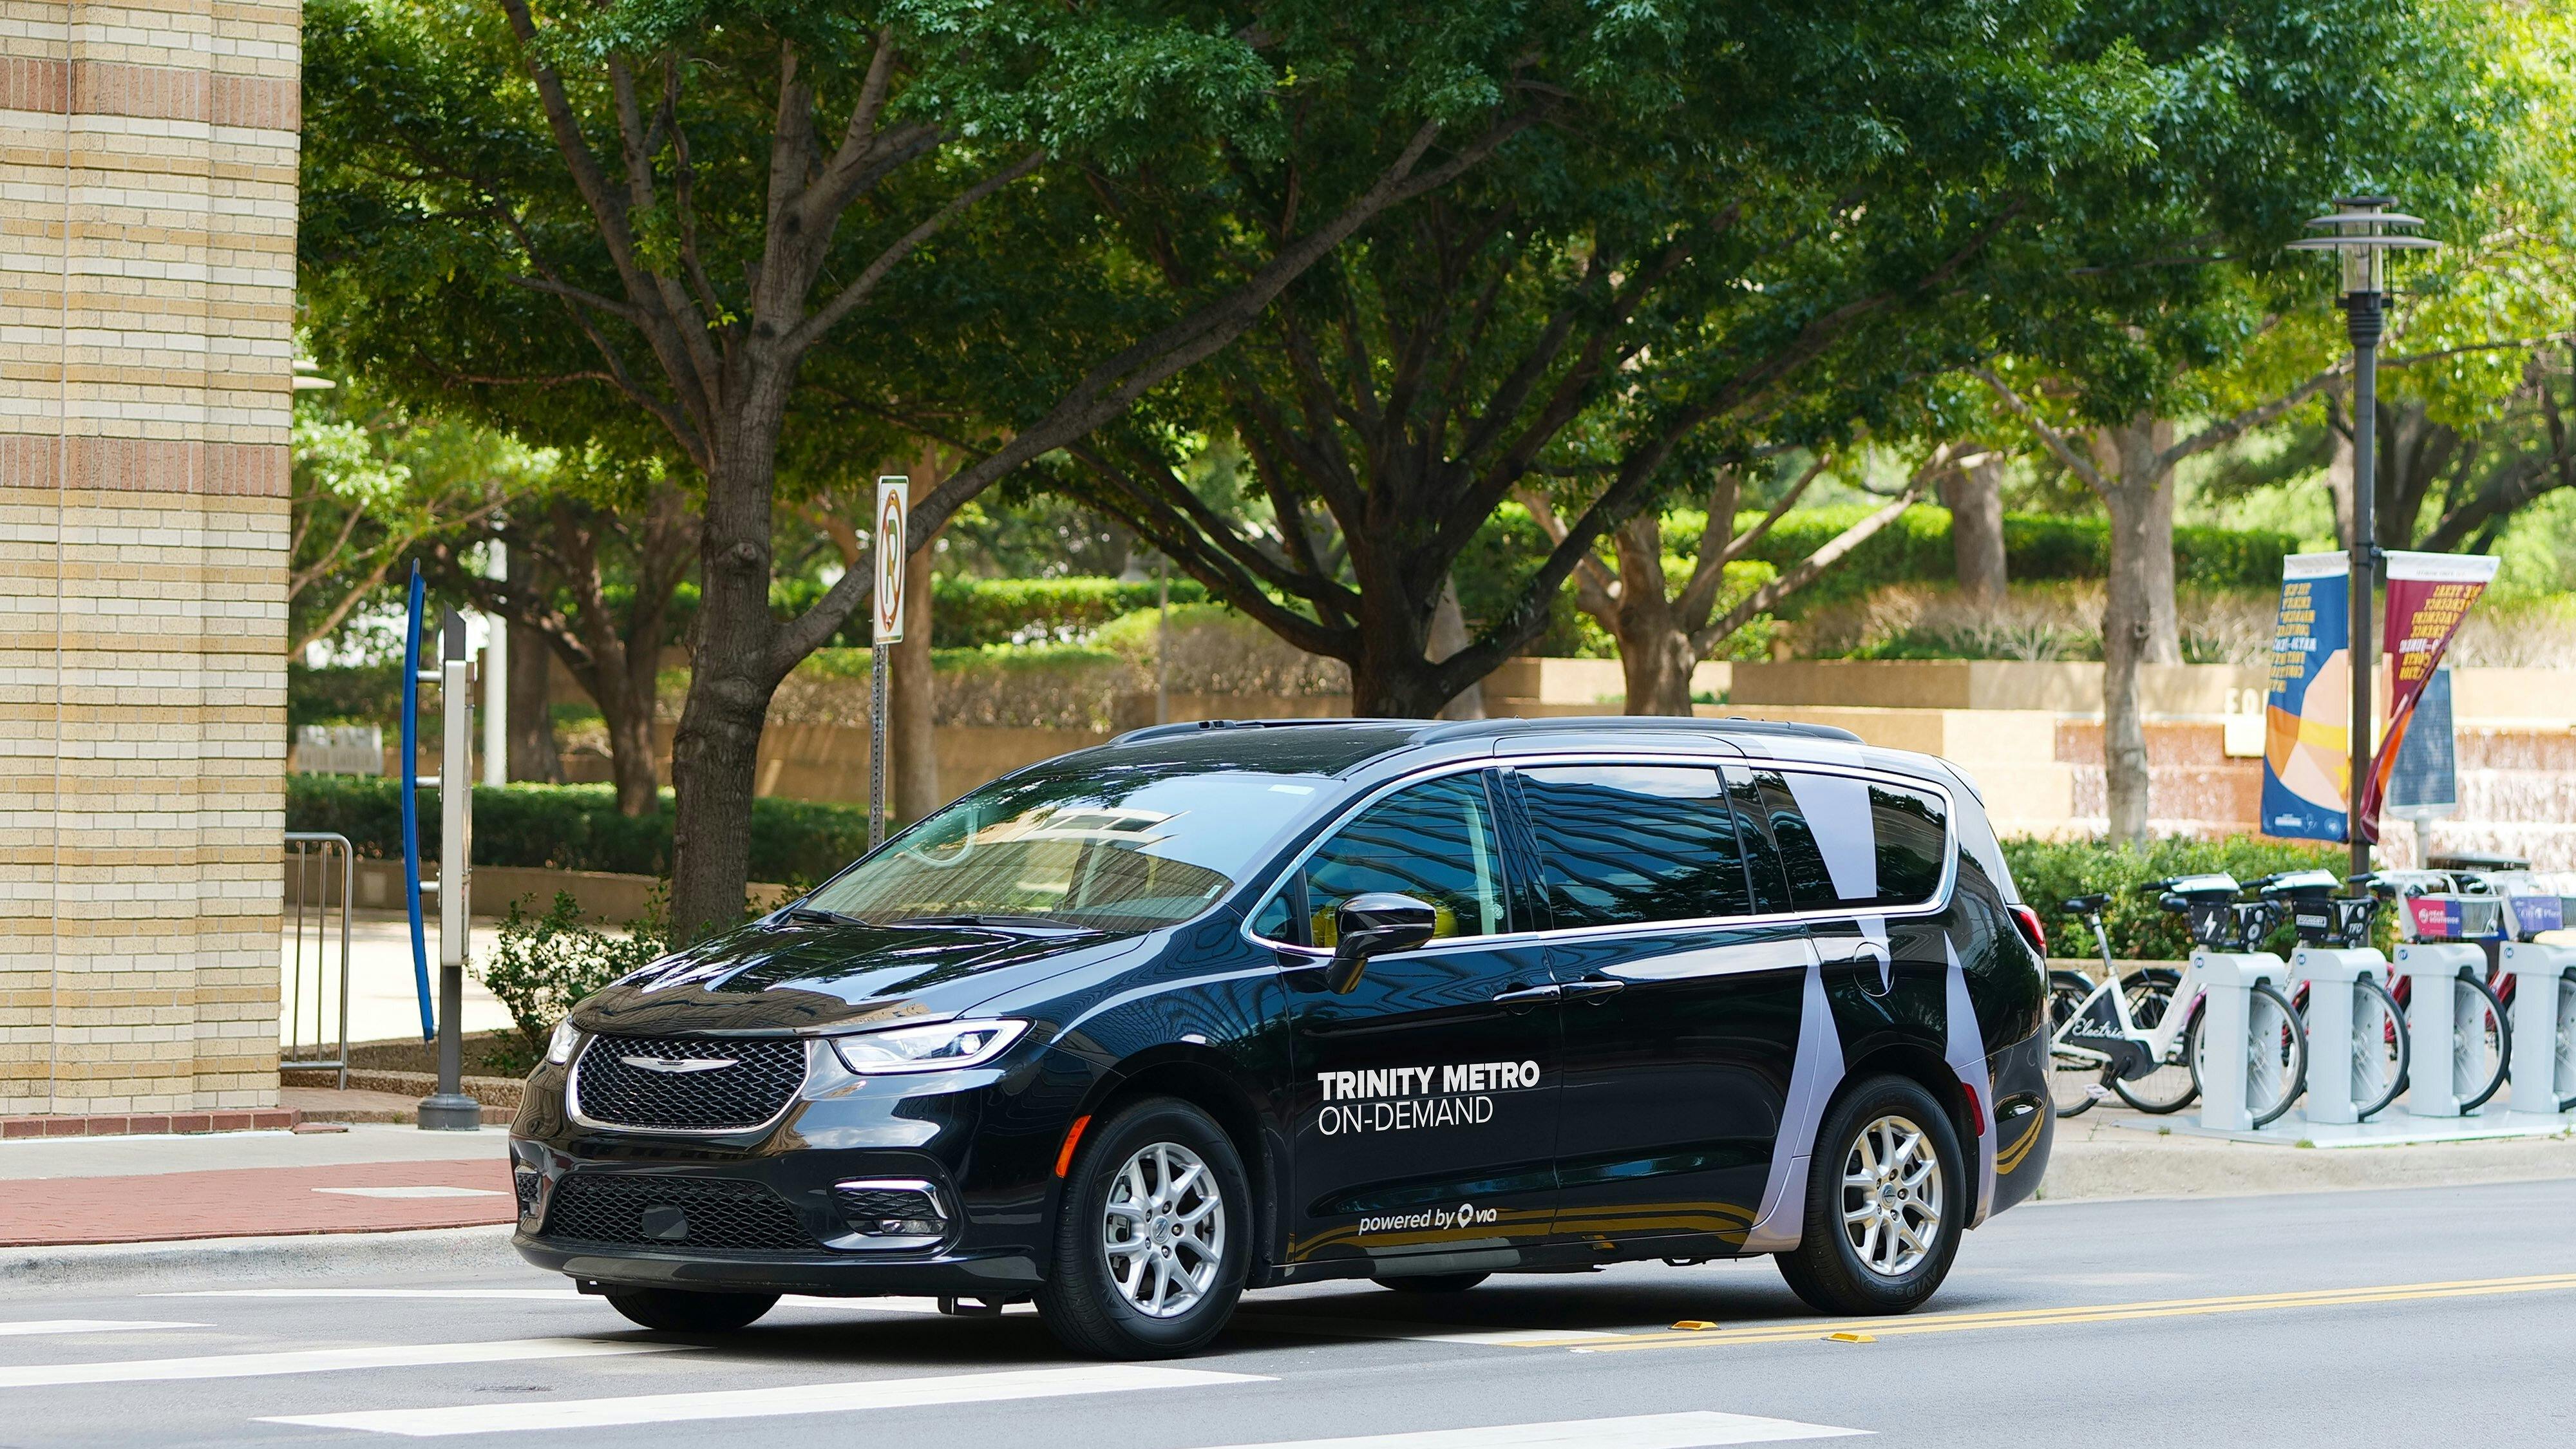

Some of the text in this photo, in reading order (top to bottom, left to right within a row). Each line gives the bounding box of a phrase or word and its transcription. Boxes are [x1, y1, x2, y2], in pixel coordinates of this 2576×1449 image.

[2072, 1018, 2125, 1039] Electric
[1318, 1060, 1540, 1101] TRINITY METRO
[1318, 1096, 1493, 1135] ON-DEMAND
[1358, 1209, 1432, 1236] powered
[1434, 1208, 1456, 1230] by
